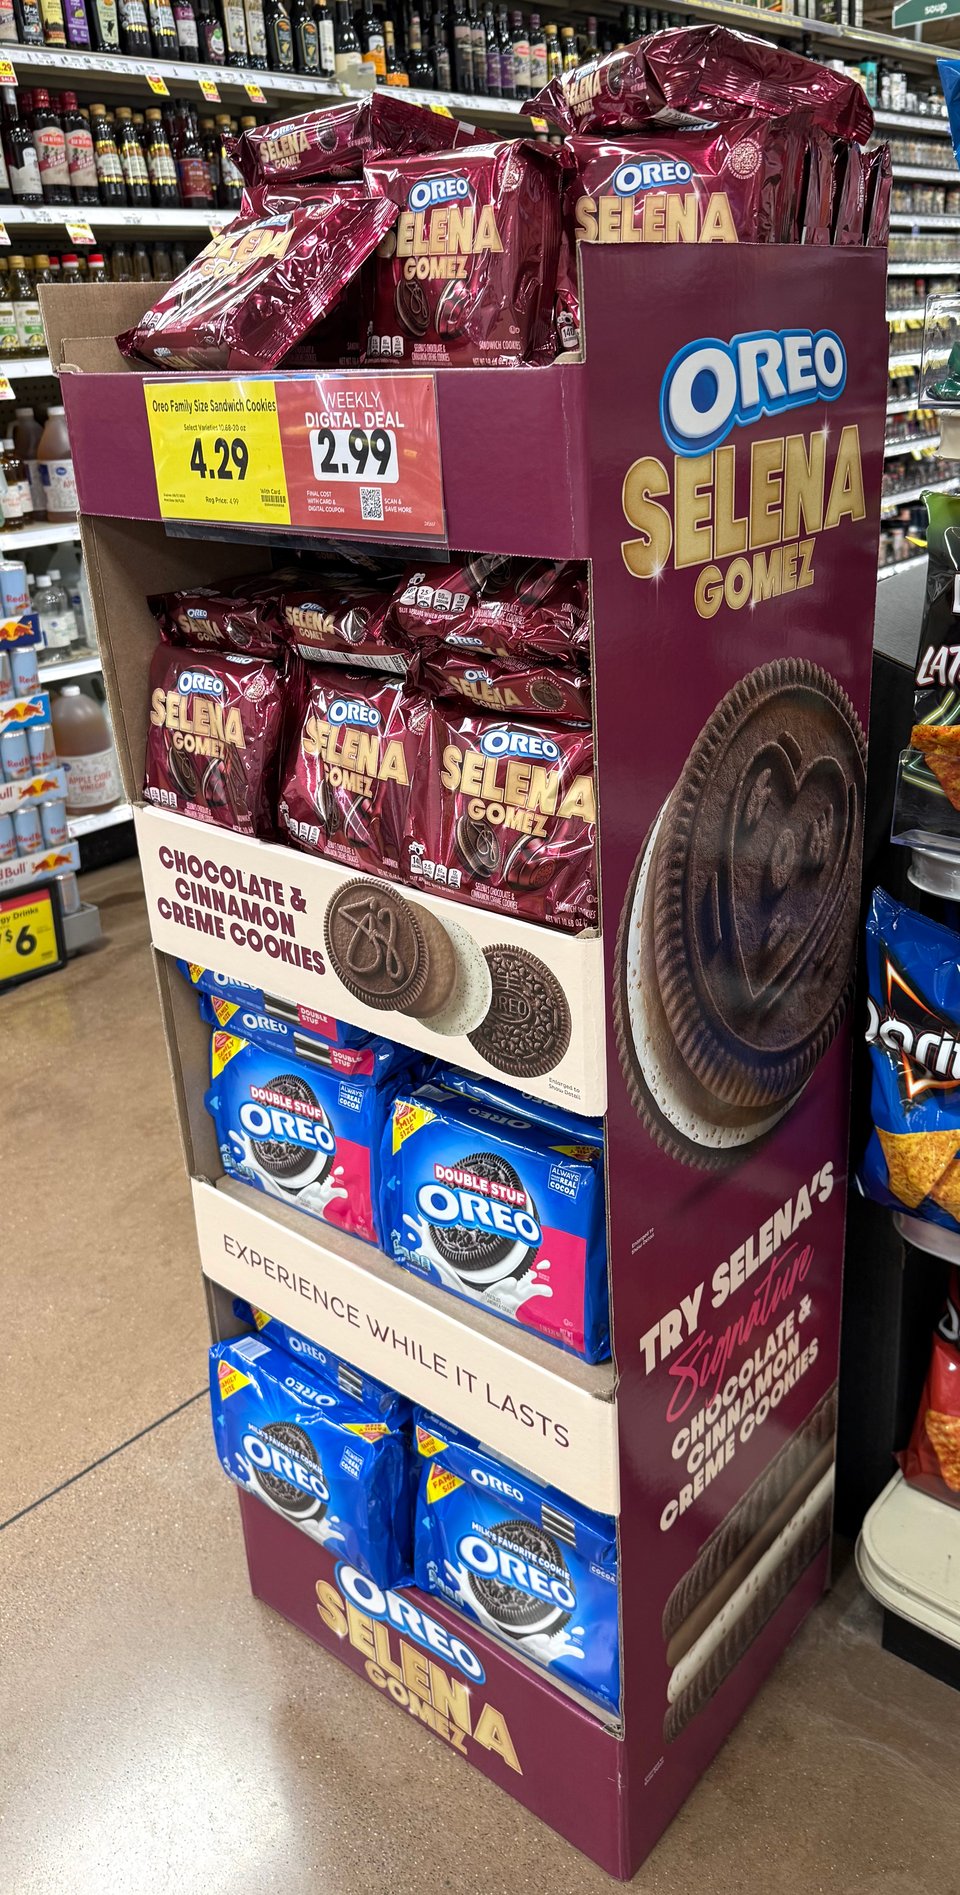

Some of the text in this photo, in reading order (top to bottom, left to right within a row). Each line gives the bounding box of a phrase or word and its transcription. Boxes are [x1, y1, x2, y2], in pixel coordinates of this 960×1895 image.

[259, 131, 311, 163] SELENA
[274, 154, 300, 169] GOMEZ
[615, 162, 691, 194] OREO
[410, 178, 469, 210] OREO
[574, 192, 739, 243] SELENA
[404, 256, 467, 281] GOMEZ
[479, 340, 521, 350] SANDWICH COOKIES
[325, 391, 381, 410] WEEKLY
[663, 331, 846, 446] OREO
[152, 397, 276, 415] Oreo Family Size Sandwich Cookies
[305, 411, 405, 428] DIGITAL DEAL
[184, 423, 197, 432] Select
[197, 423, 219, 432] Varieties
[190, 437, 249, 481] 4.29
[317, 427, 392, 477] 2.99
[205, 496, 239, 505] Reg Price: 4.99
[621, 424, 867, 580] SELENA
[694, 537, 816, 619] GOMEZ
[187, 608, 208, 619] OREO
[285, 606, 335, 635] SELENA
[299, 627, 325, 641] GOMEZ
[445, 635, 483, 647] OREO
[177, 671, 225, 695] OREO
[150, 688, 247, 749] SELENA
[327, 698, 382, 727] OREO
[172, 730, 226, 760] GOMEZ
[303, 714, 410, 787] SELENA
[480, 729, 561, 761] OREO
[69, 770, 112, 786] APPLE CIDER
[79, 781, 106, 793] VINEGAR
[323, 765, 373, 799] GOMEZ
[441, 743, 597, 825] SELENA
[467, 798, 549, 839] GOMEZ
[5, 862, 26, 878] Bull
[158, 845, 308, 914] CHOCOLATE &
[490, 886, 511, 900] CHOCOLATE
[511, 892, 516, 901] &
[502, 898, 518, 910] COOKIES
[13, 906, 39, 920] Drinks
[175, 879, 295, 939] CINNAMON
[575, 918, 583, 927] OZ
[158, 897, 327, 977] CREME COOKIES
[242, 1013, 288, 1035] OREO
[300, 1007, 328, 1023] DOUBLE
[302, 1014, 319, 1025] STUF
[332, 1049, 362, 1064] DOUBLE
[333, 1056, 352, 1068] STUF
[340, 1085, 363, 1098] ALWAYS
[347, 1093, 361, 1105] REAL
[548, 1076, 581, 1094] Enlarged to
[548, 1084, 582, 1101] Show Detail
[251, 1086, 323, 1120] DOUBLE STUF
[339, 1097, 360, 1111] COCOA
[239, 1102, 336, 1154] OREO
[399, 1123, 415, 1140] SIZE
[435, 1165, 526, 1206] DOUBLE STUF
[551, 1166, 580, 1183] ALWAYS
[559, 1175, 577, 1189] REAL
[549, 1181, 575, 1198] COCOA
[418, 1186, 540, 1245] OREO
[640, 1161, 835, 1376] TRY SELENA'S
[223, 1234, 571, 1449] EXPERIENCE WHILE IT LASTS
[666, 1242, 815, 1422] Signature
[289, 1336, 327, 1365] OREO
[224, 1381, 236, 1395] SIZE
[671, 1293, 813, 1459] CHOCOLATE &
[285, 1376, 337, 1407] OREO
[686, 1331, 800, 1475] CINNAMON
[248, 1422, 324, 1476] MILK'S FAVORITE COOKIE
[660, 1337, 819, 1532] CREME COOKIES
[243, 1434, 331, 1502] OREO
[344, 1447, 364, 1463] ALWAYS
[347, 1458, 361, 1471] REAL
[340, 1461, 360, 1479] COCOA
[442, 1480, 456, 1494] SIZE
[471, 1469, 524, 1503] OREO
[472, 1521, 570, 1580] MILK'S FAVORITE COOKIE
[458, 1535, 576, 1610] OREO
[591, 1565, 616, 1583] COCOA
[339, 1564, 482, 1680] OREO
[316, 1580, 524, 1776] SELENA
[364, 1659, 469, 1755] GOMEZ
